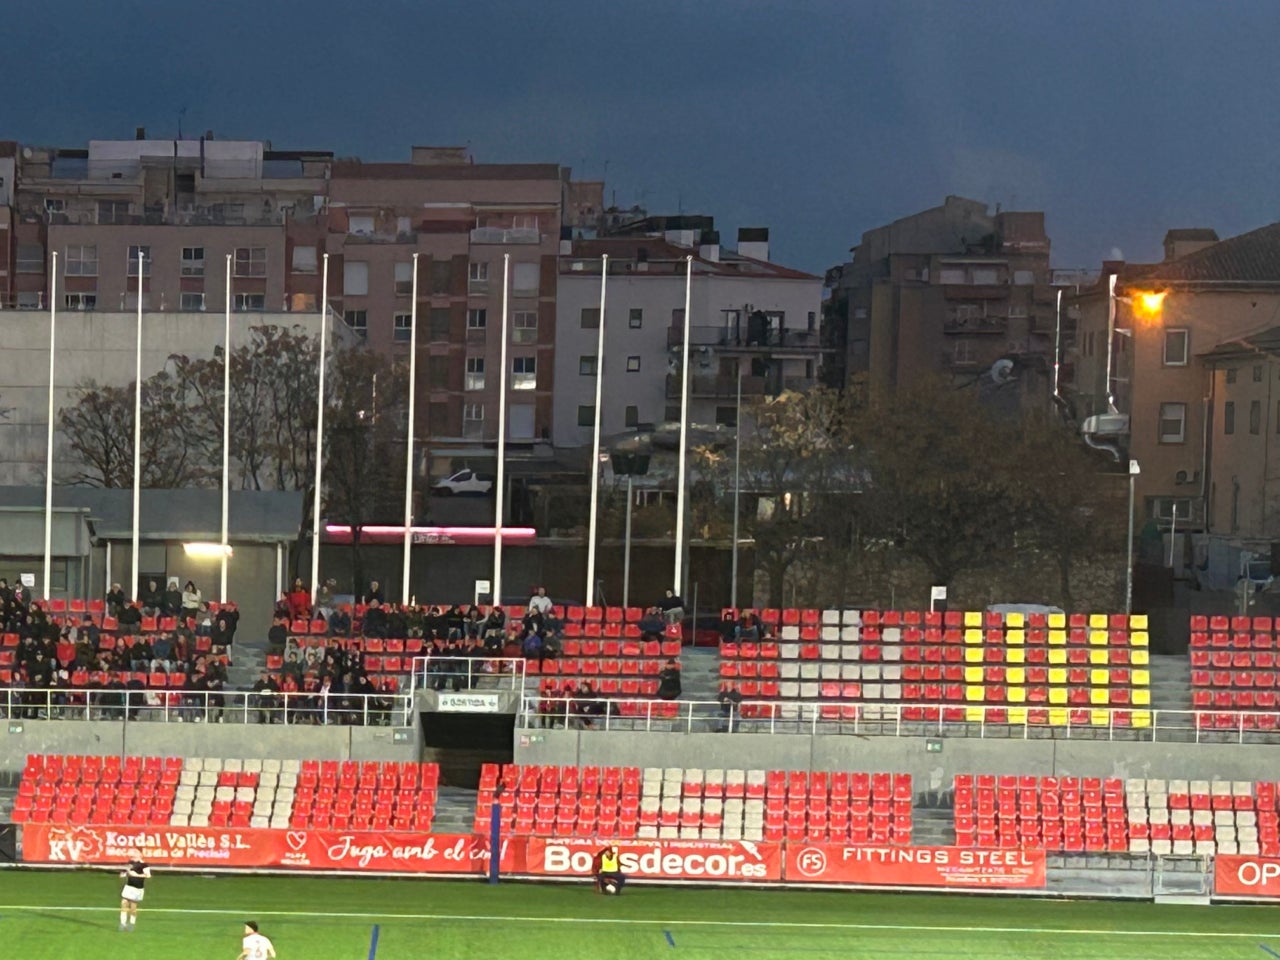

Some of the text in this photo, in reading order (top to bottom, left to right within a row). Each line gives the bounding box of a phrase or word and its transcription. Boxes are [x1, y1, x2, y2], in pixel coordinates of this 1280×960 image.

[106, 831, 160, 847] Kordal
[166, 832, 216, 848] Vallès
[49, 841, 84, 860] KV
[328, 836, 387, 867] Juga
[393, 837, 438, 860] amb
[843, 848, 1034, 865] FITTINGS STEEL
[802, 853, 821, 869] FS
